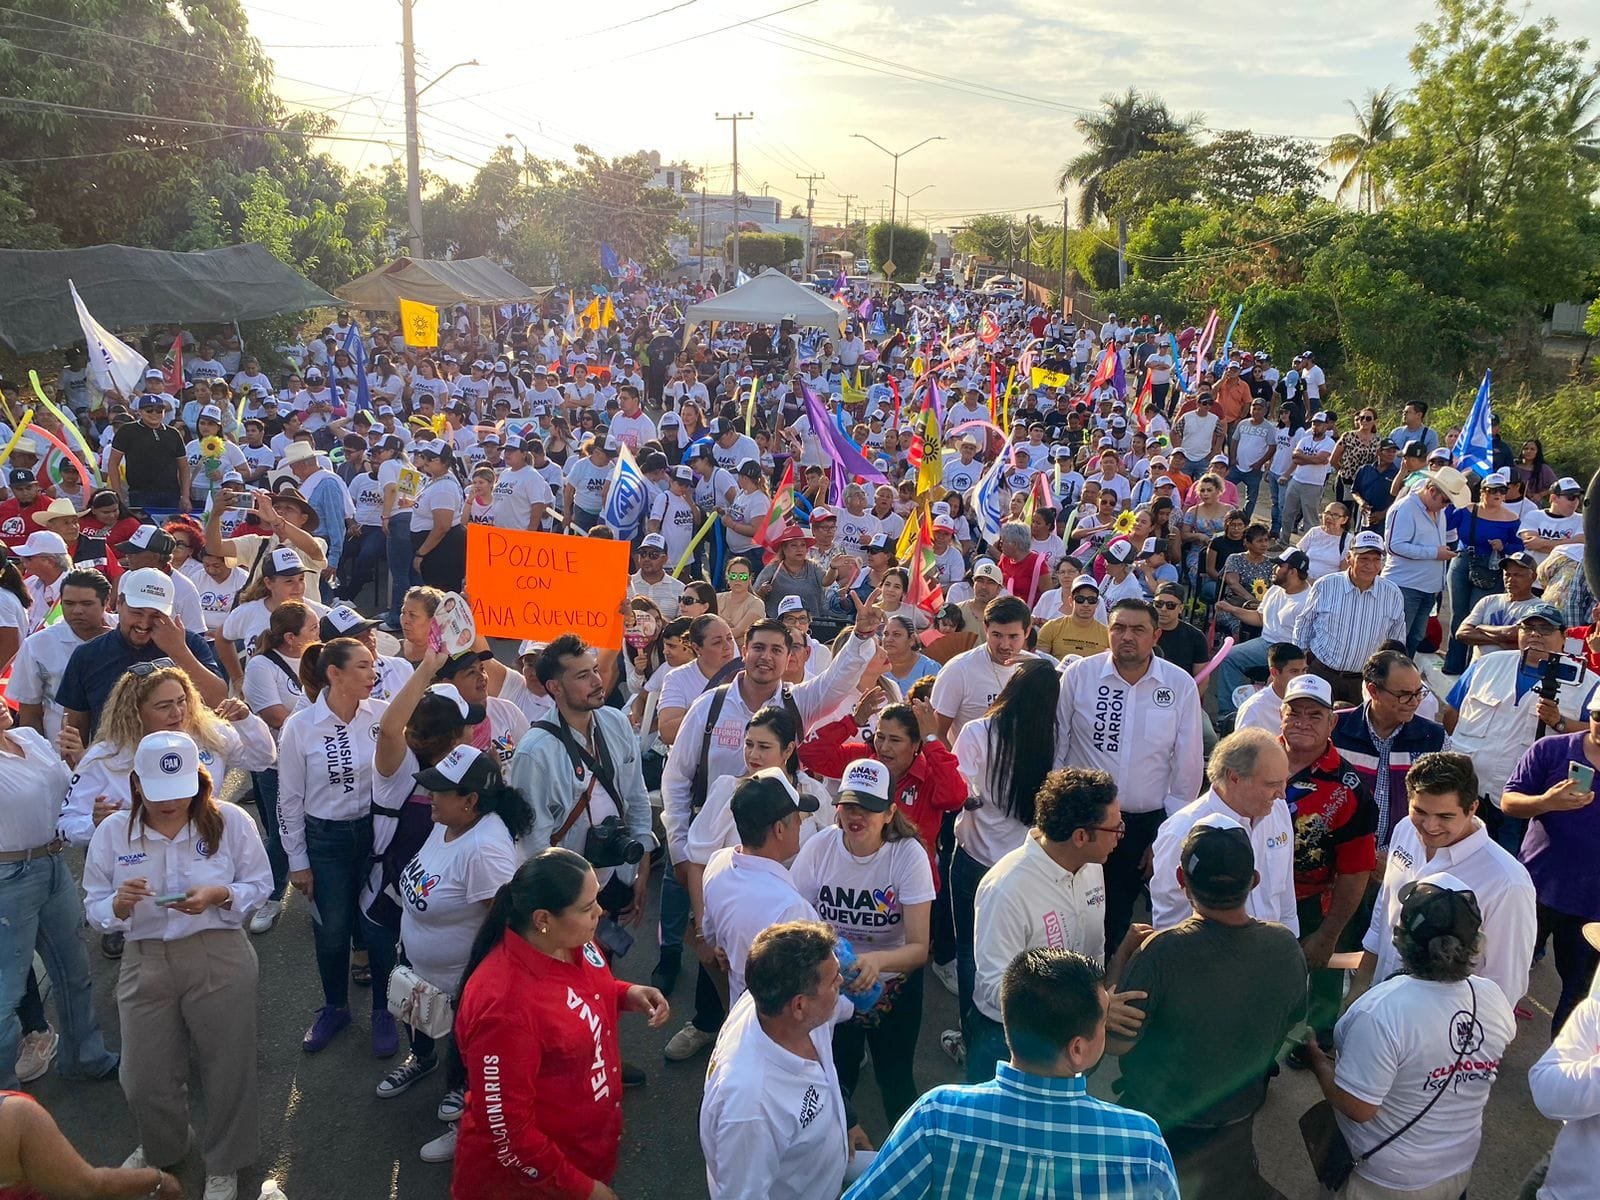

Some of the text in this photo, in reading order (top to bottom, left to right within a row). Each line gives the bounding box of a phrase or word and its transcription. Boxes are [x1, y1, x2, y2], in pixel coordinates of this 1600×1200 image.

[1240, 424, 1275, 438] GUESS
[468, 514, 489, 523] ANA
[486, 532, 577, 575] POZOLE
[514, 574, 552, 591] CON
[473, 598, 515, 628] ANA
[523, 602, 608, 629] QUEVEDO
[1093, 685, 1110, 753] ARCADIO
[1106, 689, 1124, 753] BARRÓN
[163, 757, 180, 769] PAN
[323, 735, 341, 785] AGUILAR
[334, 724, 354, 795] ANNSHAIRA
[849, 765, 870, 776] ANA
[848, 773, 877, 784] QUEVEDO
[1393, 850, 1413, 869] ORTIZ
[819, 885, 877, 911] ANA
[819, 903, 902, 927] QUEVEDO
[802, 1089, 820, 1129] ORTIZ
